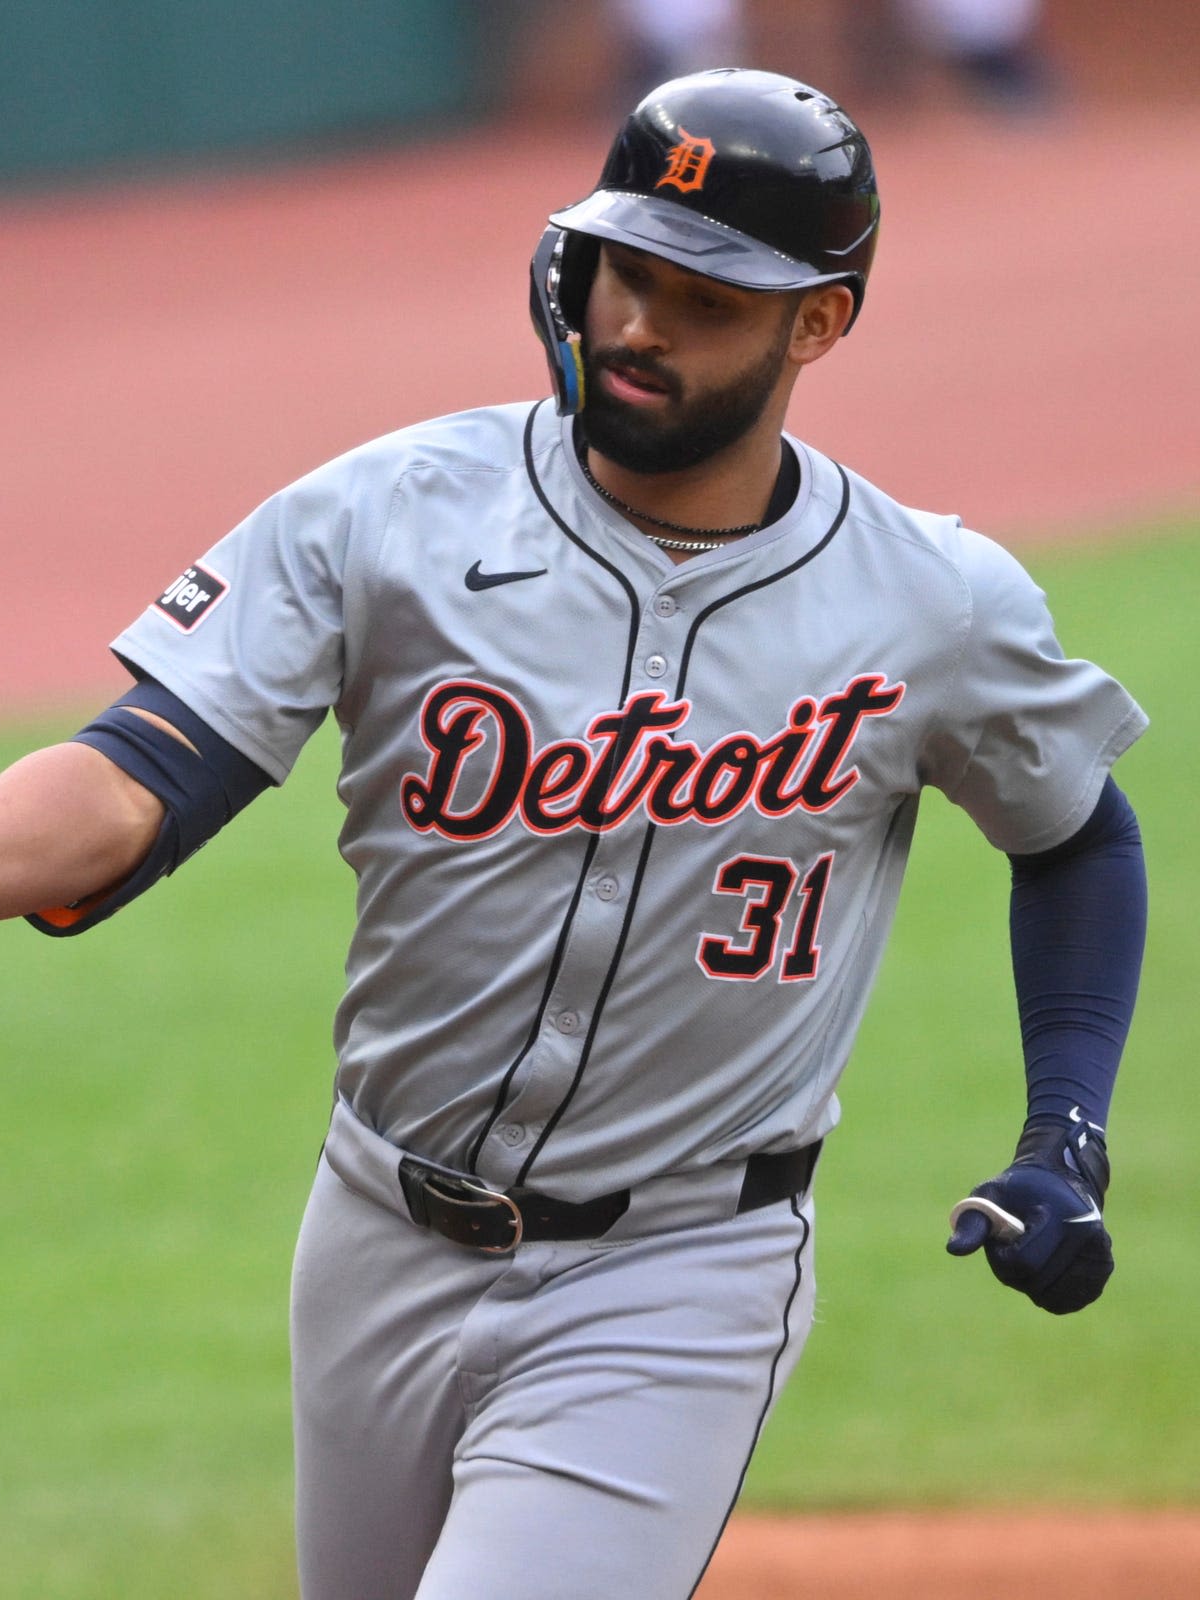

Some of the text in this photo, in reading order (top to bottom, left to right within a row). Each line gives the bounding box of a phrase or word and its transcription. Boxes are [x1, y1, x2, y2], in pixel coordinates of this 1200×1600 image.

[656, 126, 716, 193] D
[401, 673, 906, 841] Detroit
[697, 852, 835, 982] 31
